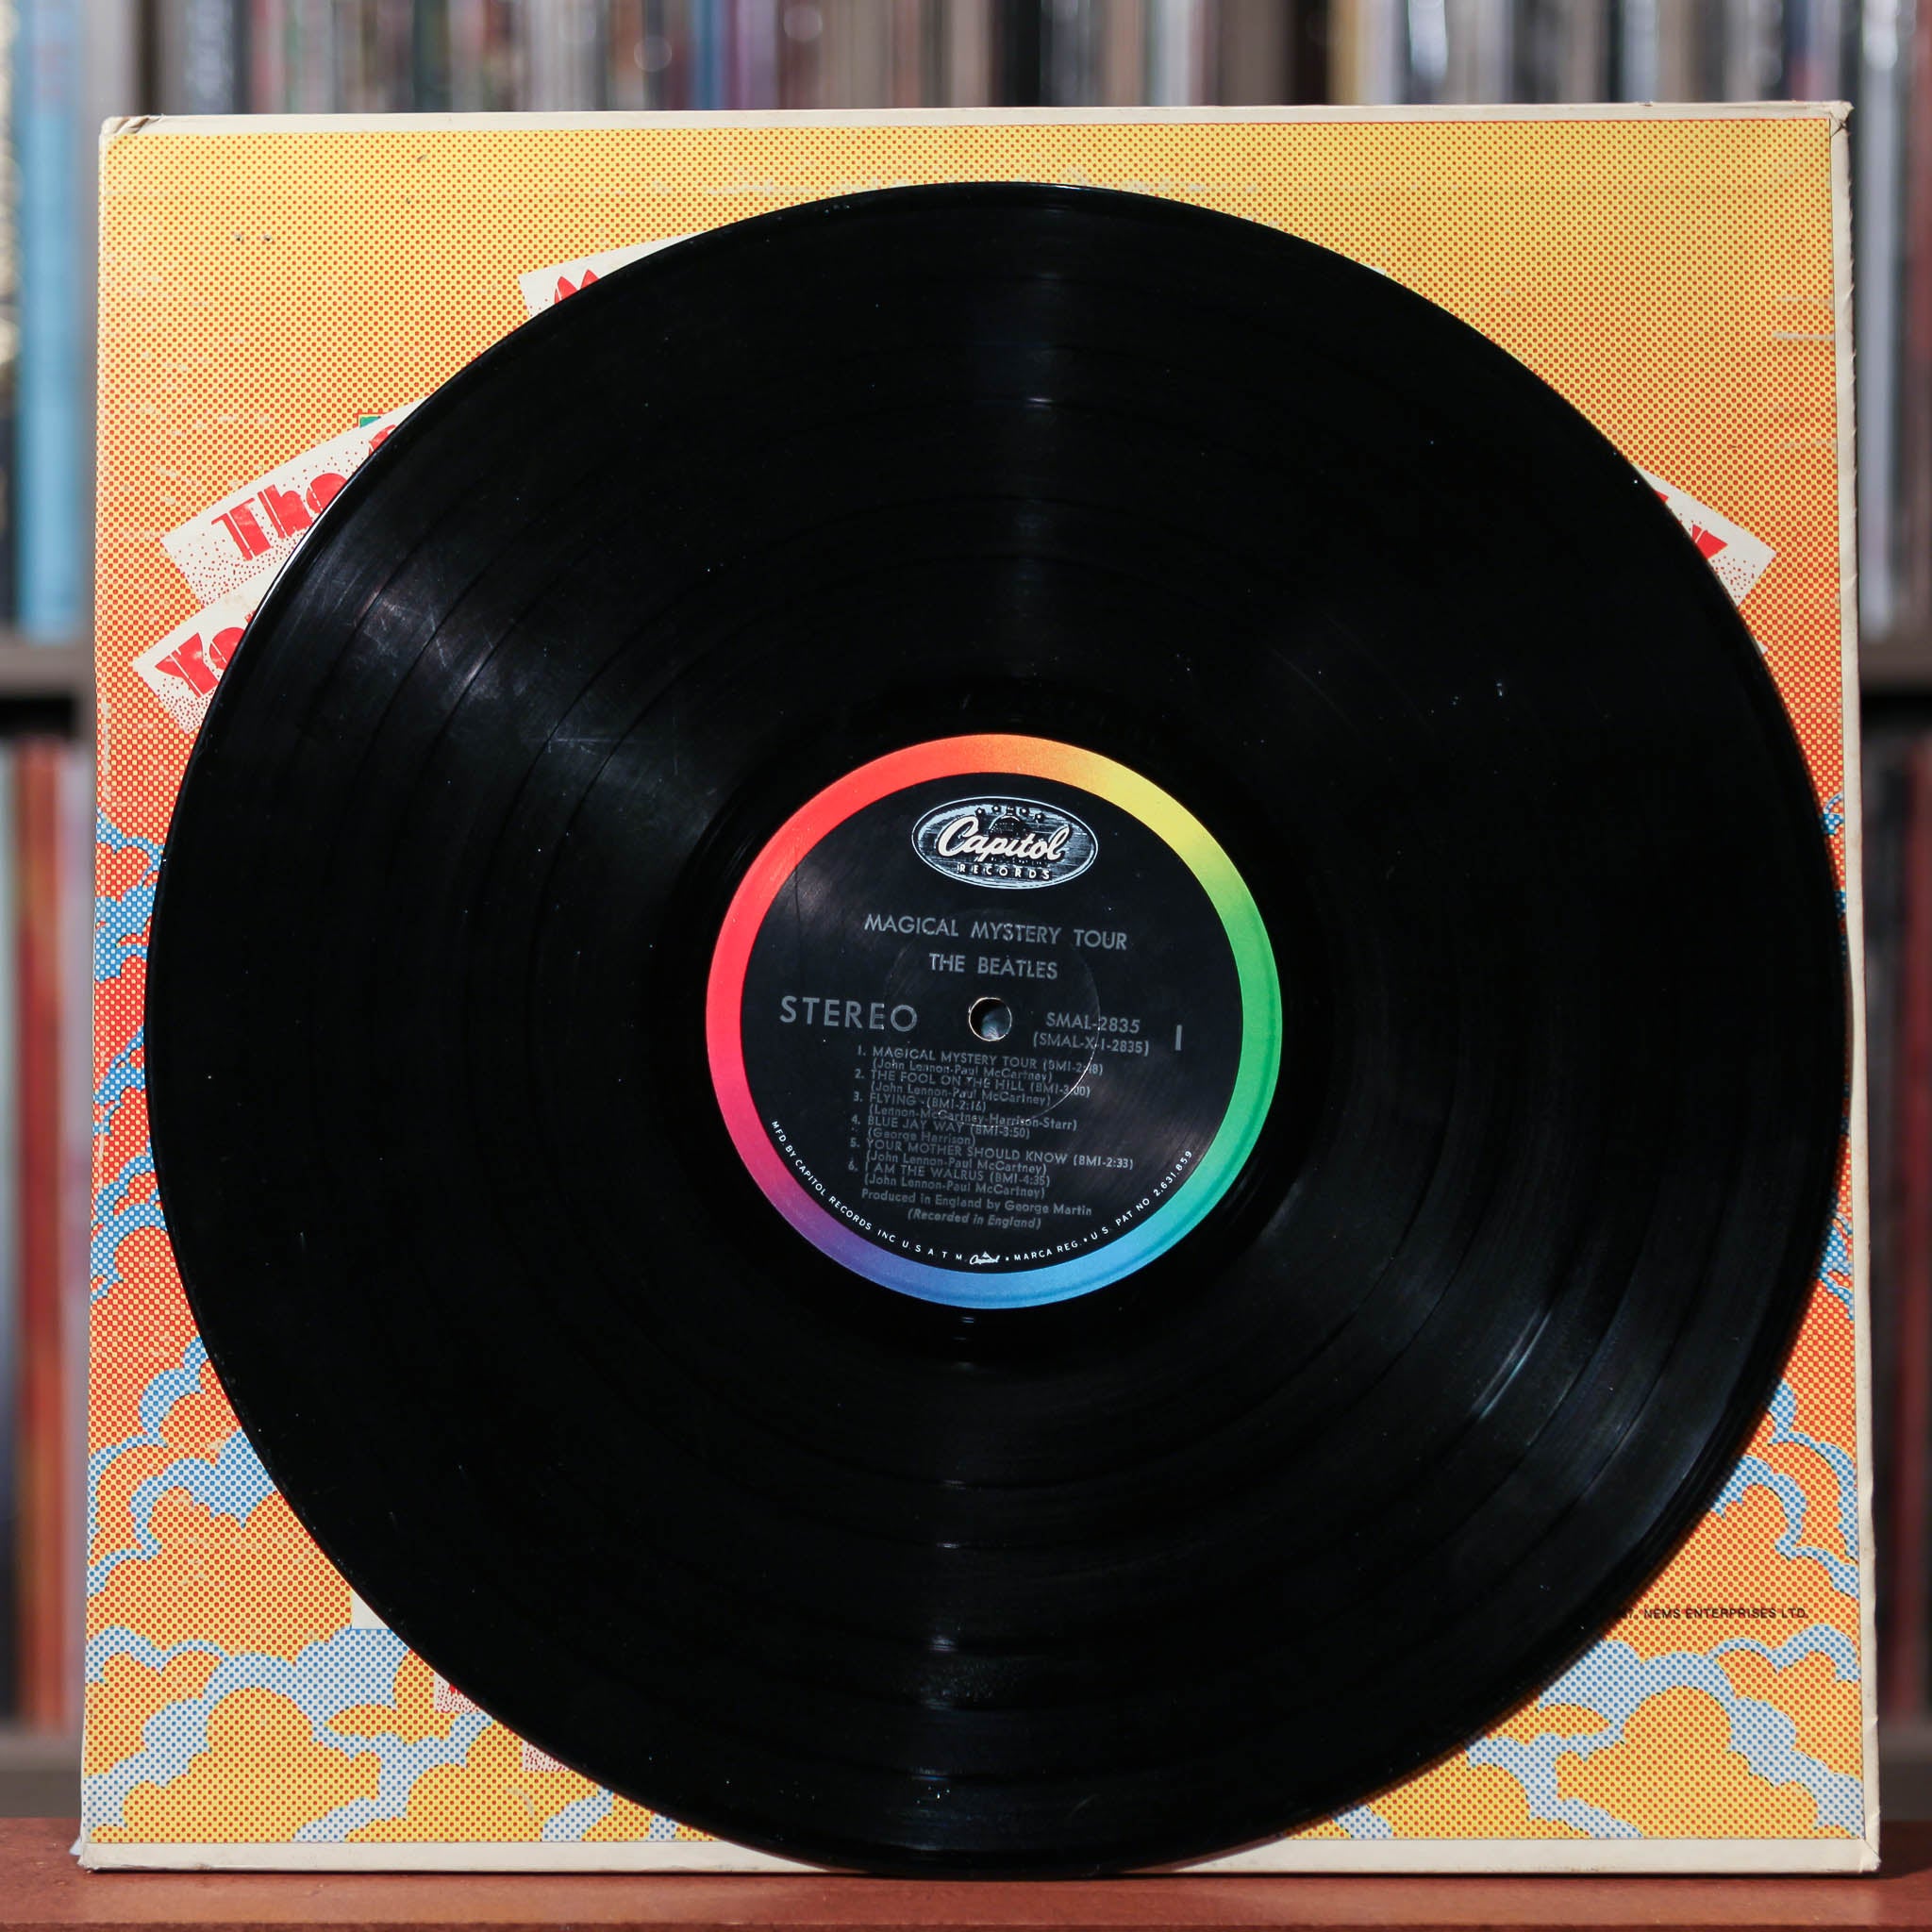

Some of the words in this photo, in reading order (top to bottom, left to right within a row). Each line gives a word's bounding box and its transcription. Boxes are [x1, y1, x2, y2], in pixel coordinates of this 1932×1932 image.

[938, 815, 1071, 862] Capitol
[958, 863, 1051, 880] RECORDS
[864, 913, 959, 938] MAGICAL
[970, 921, 1062, 944] MYSTERY
[1074, 928, 1127, 951] TOUR
[928, 953, 966, 974] THE
[977, 956, 1058, 980] BEATLES
[779, 995, 918, 1032] STEREO
[1045, 1011, 1141, 1034] SMAL-2835
[873, 1046, 936, 1061] MAGICAL
[941, 1051, 996, 1066] MYSTERY
[1003, 1056, 1038, 1070] TOUR
[855, 1069, 865, 1079] 2.
[871, 1069, 895, 1081] THE
[900, 1072, 936, 1085] FOOL
[941, 1075, 961, 1086] ON
[966, 1076, 991, 1089] THE
[995, 1078, 1024, 1091] HILL
[983, 1067, 1053, 1083] McCartney)
[853, 1091, 863, 1102] 3.
[869, 1092, 917, 1106] FLYING
[981, 1091, 1051, 1106] McCartney)
[851, 1114, 860, 1124] 4.
[868, 1116, 898, 1127] BLUE
[903, 1119, 927, 1130] JAY
[933, 1121, 964, 1133] WAY
[850, 1137, 860, 1148] 5.
[866, 1139, 903, 1151] YOUR
[908, 1142, 962, 1157] MOTHER
[968, 1146, 1021, 1160] SHOULD
[1025, 1150, 1068, 1165] KNOW
[1073, 1154, 1133, 1171] (BMI-2:33)
[848, 1161, 858, 1172] 6.
[874, 1163, 895, 1174] AM
[901, 1165, 925, 1177] THE
[930, 1167, 984, 1180] WALRUS
[977, 1159, 1047, 1175] McCartney)
[861, 1188, 916, 1204] Produced
[921, 1193, 931, 1205] in
[935, 1194, 982, 1209] England
[987, 1199, 1000, 1212] by
[1005, 1200, 1049, 1215] George
[1053, 1203, 1091, 1216] Martin
[975, 1183, 1045, 1199] McCartney)
[785, 1144, 796, 1158] BY
[795, 1159, 826, 1196] CAPITOL
[828, 1195, 873, 1230] RECORDS
[1014, 1248, 1053, 1262] MARCA
[908, 1208, 970, 1224] (Recorded
[974, 1212, 984, 1224] in
[988, 1214, 1041, 1230] England)
[1644, 1608, 1681, 1619] NEMS
[1686, 1608, 1776, 1619] ENTERPRISES
[1782, 1607, 1808, 1619] LTD.
